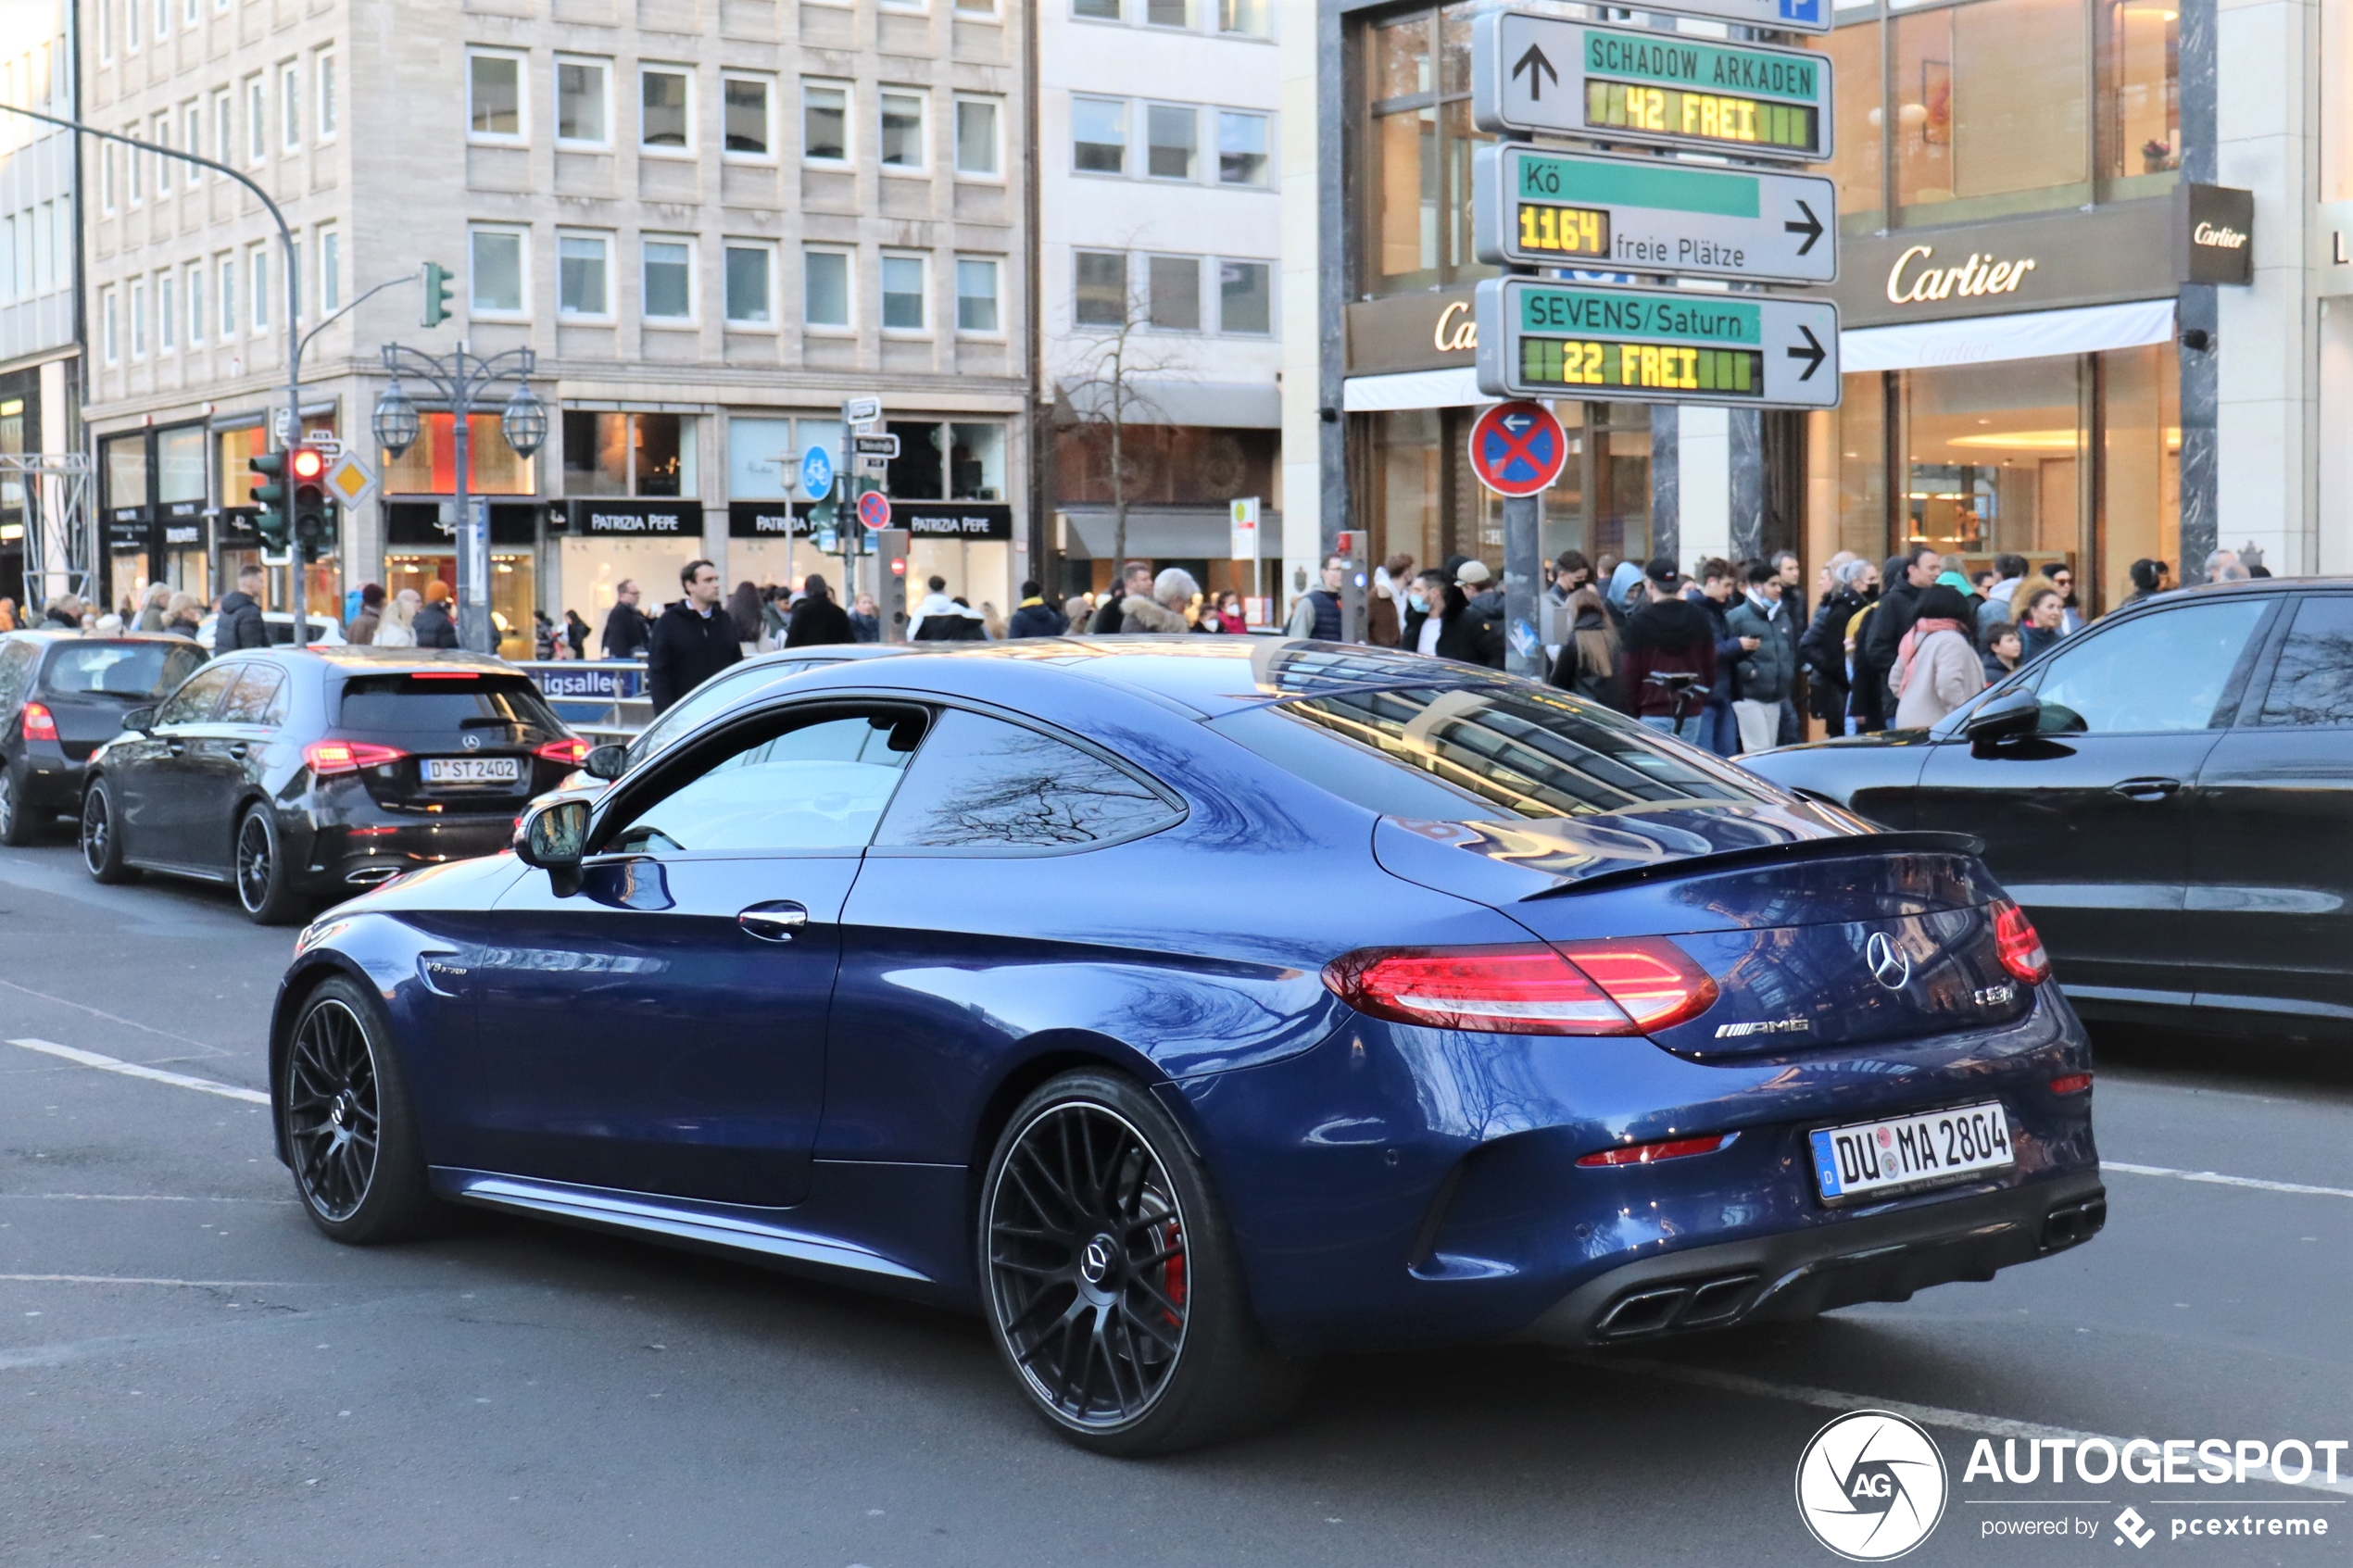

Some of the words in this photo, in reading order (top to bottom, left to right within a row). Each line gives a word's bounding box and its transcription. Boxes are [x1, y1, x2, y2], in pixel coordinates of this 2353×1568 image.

[1592, 39, 1697, 80] SCHADOW
[1714, 56, 1811, 95] ARKADEN
[1627, 87, 1664, 131] 42
[1681, 94, 1755, 141] FREI
[1528, 163, 1560, 194] Kö
[1520, 207, 1600, 253] 1164
[2194, 221, 2247, 249] Cartier
[1617, 233, 1667, 261] freie
[1679, 238, 1743, 268] Plätze
[1887, 245, 2036, 305] Cartier
[1434, 301, 1478, 351] Ca
[1530, 296, 1743, 338] SEVENS/Saturn
[1564, 342, 1604, 384] 22
[1622, 345, 1698, 389] FREI
[591, 514, 645, 530] PATRIZIA
[648, 515, 679, 531] PEPE
[912, 516, 960, 533] PATRIZIA
[963, 517, 990, 533] PEPE
[432, 762, 441, 777] D
[453, 762, 472, 777] ST
[476, 761, 515, 777] 2402
[1747, 1020, 1809, 1035] AMG
[1835, 1132, 1881, 1185] DU
[1895, 1123, 1939, 1173] MA
[1939, 1111, 2008, 1167] 2804
[1824, 1171, 1833, 1185] D
